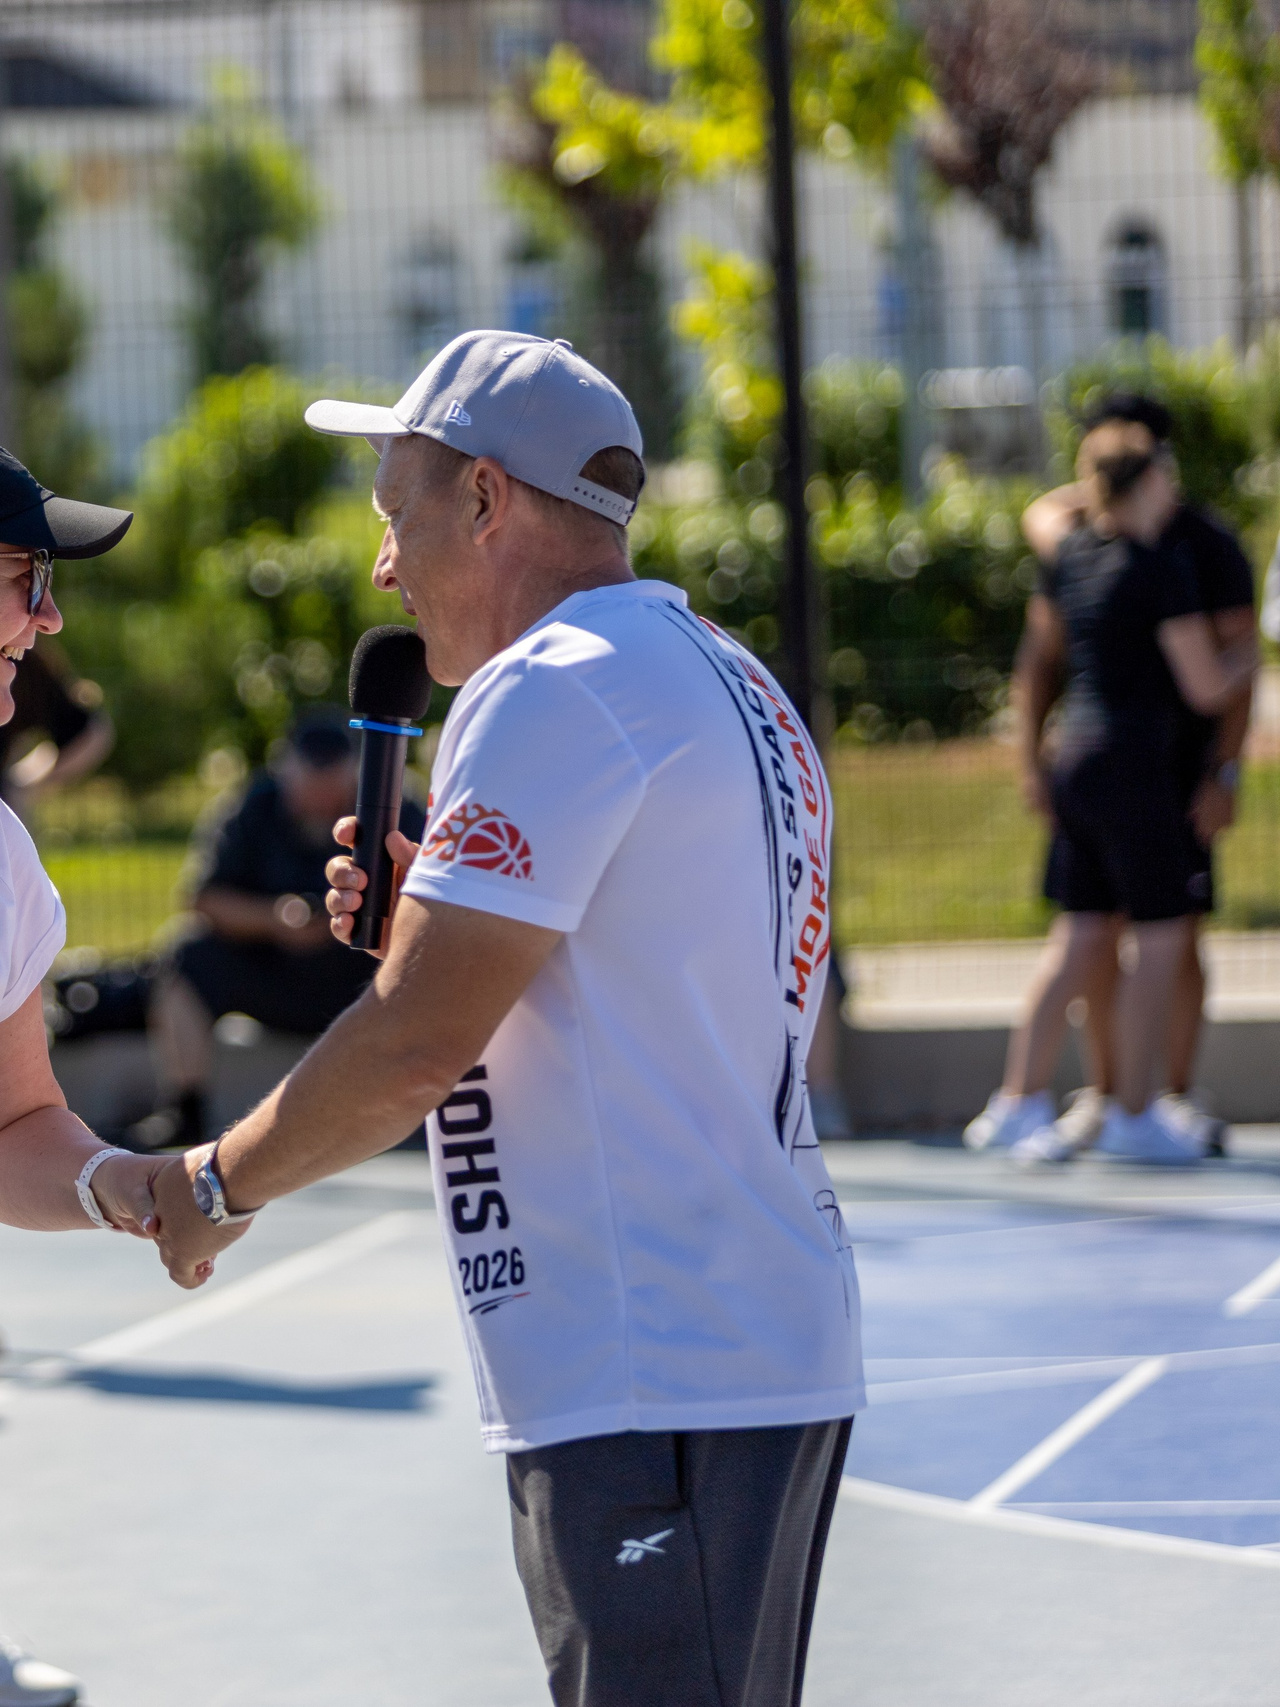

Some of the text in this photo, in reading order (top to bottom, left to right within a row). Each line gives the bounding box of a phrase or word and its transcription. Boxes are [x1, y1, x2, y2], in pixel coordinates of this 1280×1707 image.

[712, 650, 796, 839] SPACE
[735, 655, 826, 1014] MORE GAME
[436, 1064, 510, 1235] SHO
[458, 1246, 525, 1296] 2026
